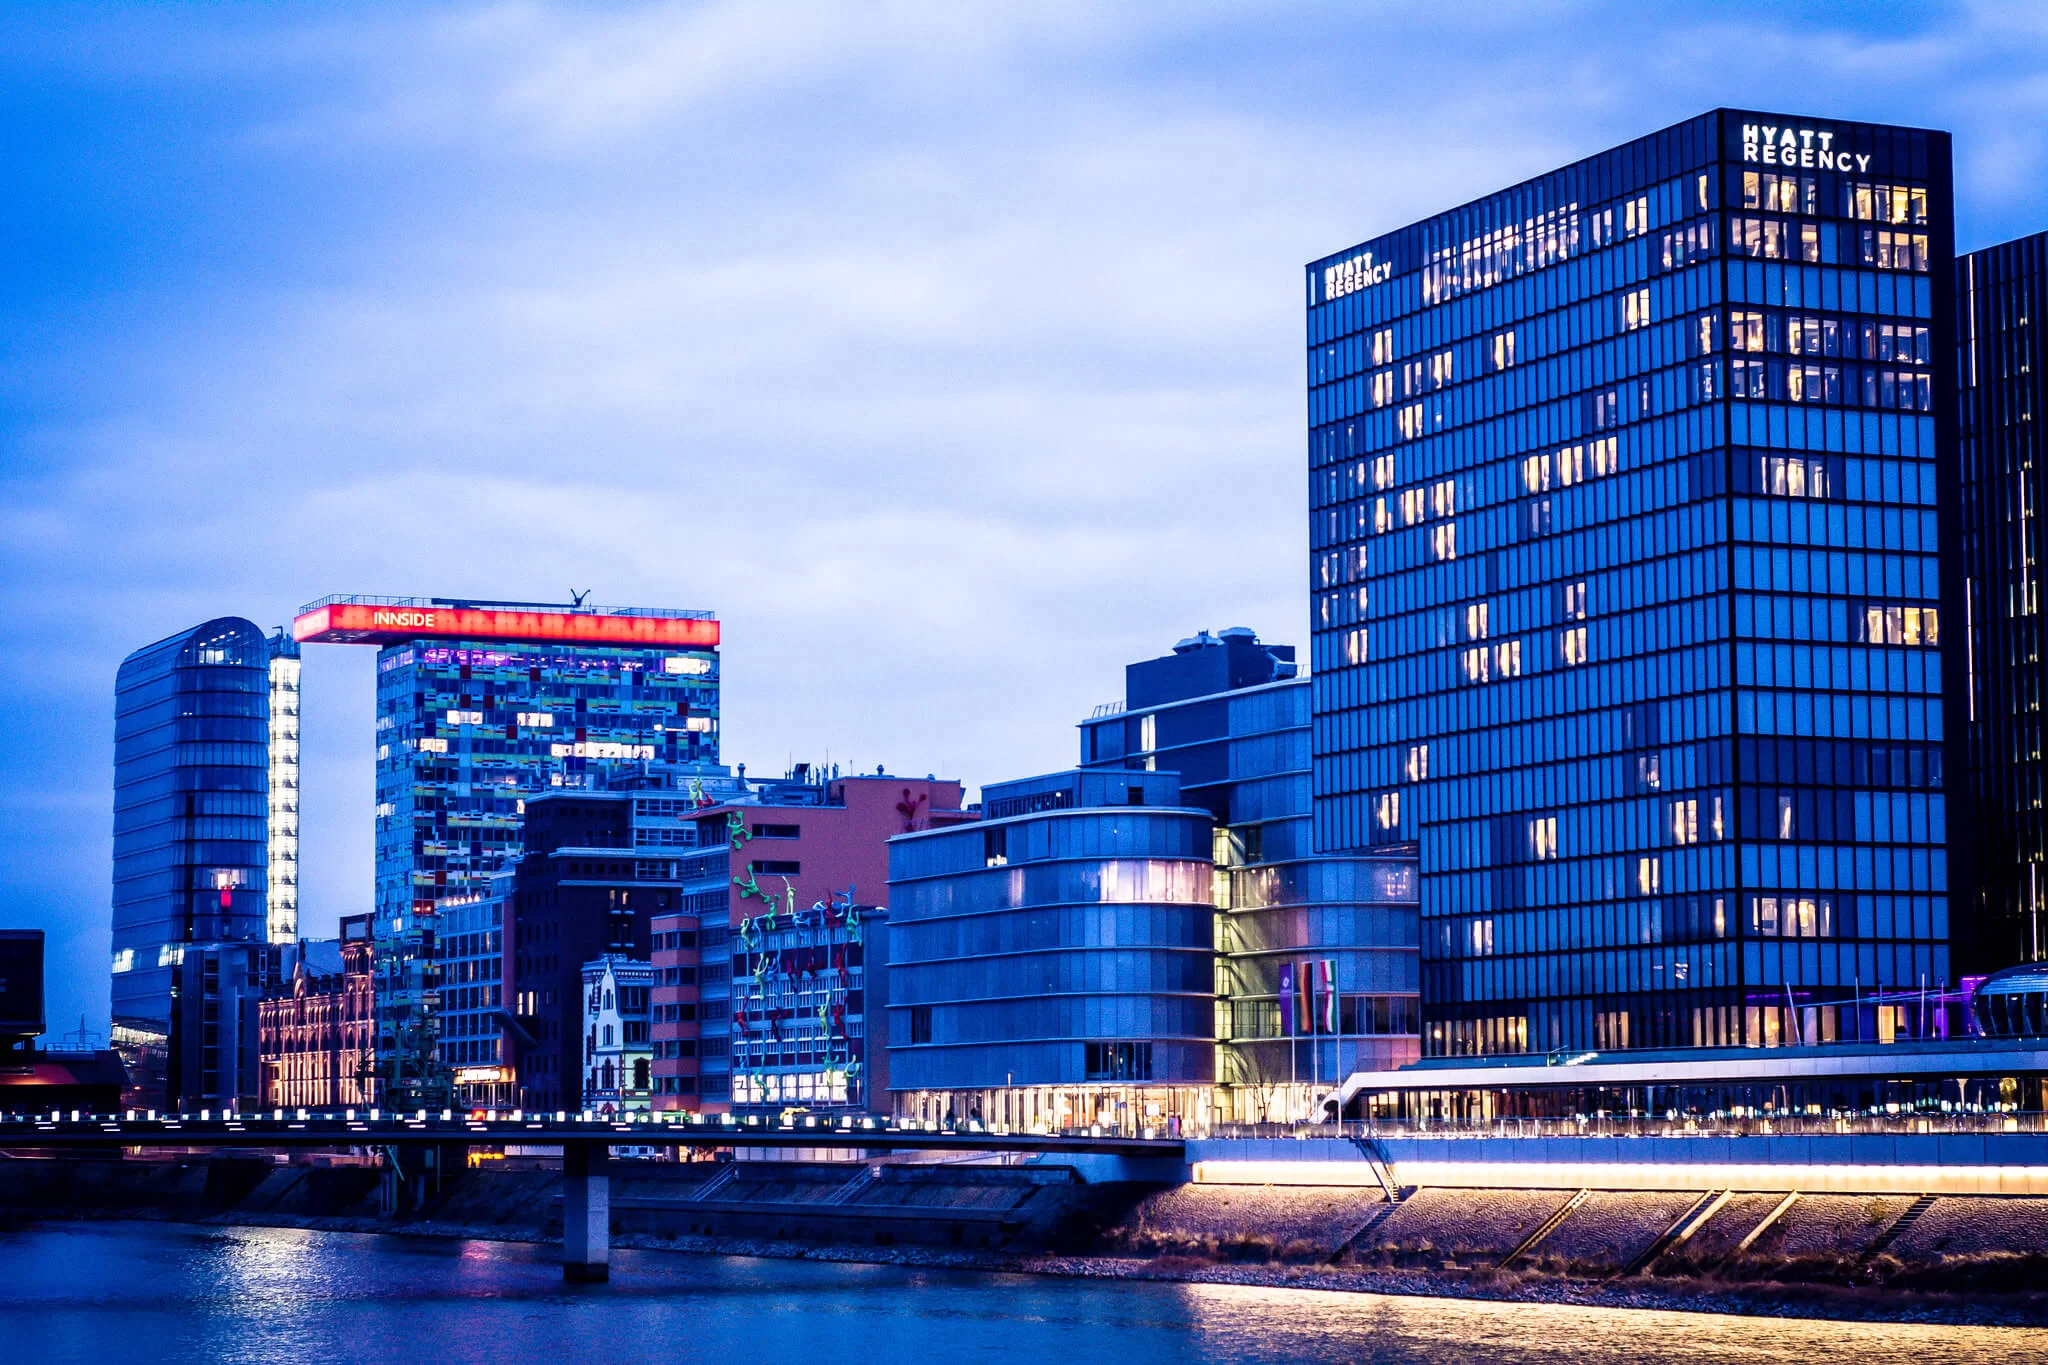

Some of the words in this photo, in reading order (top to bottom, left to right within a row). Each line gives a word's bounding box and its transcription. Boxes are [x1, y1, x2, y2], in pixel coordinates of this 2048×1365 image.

[1742, 124, 1833, 151] HYATT
[1743, 142, 1871, 173] REGENCY
[1325, 252, 1373, 282] HYATT
[1325, 261, 1392, 301] REGENCY
[373, 612, 435, 627] INNSIDE
